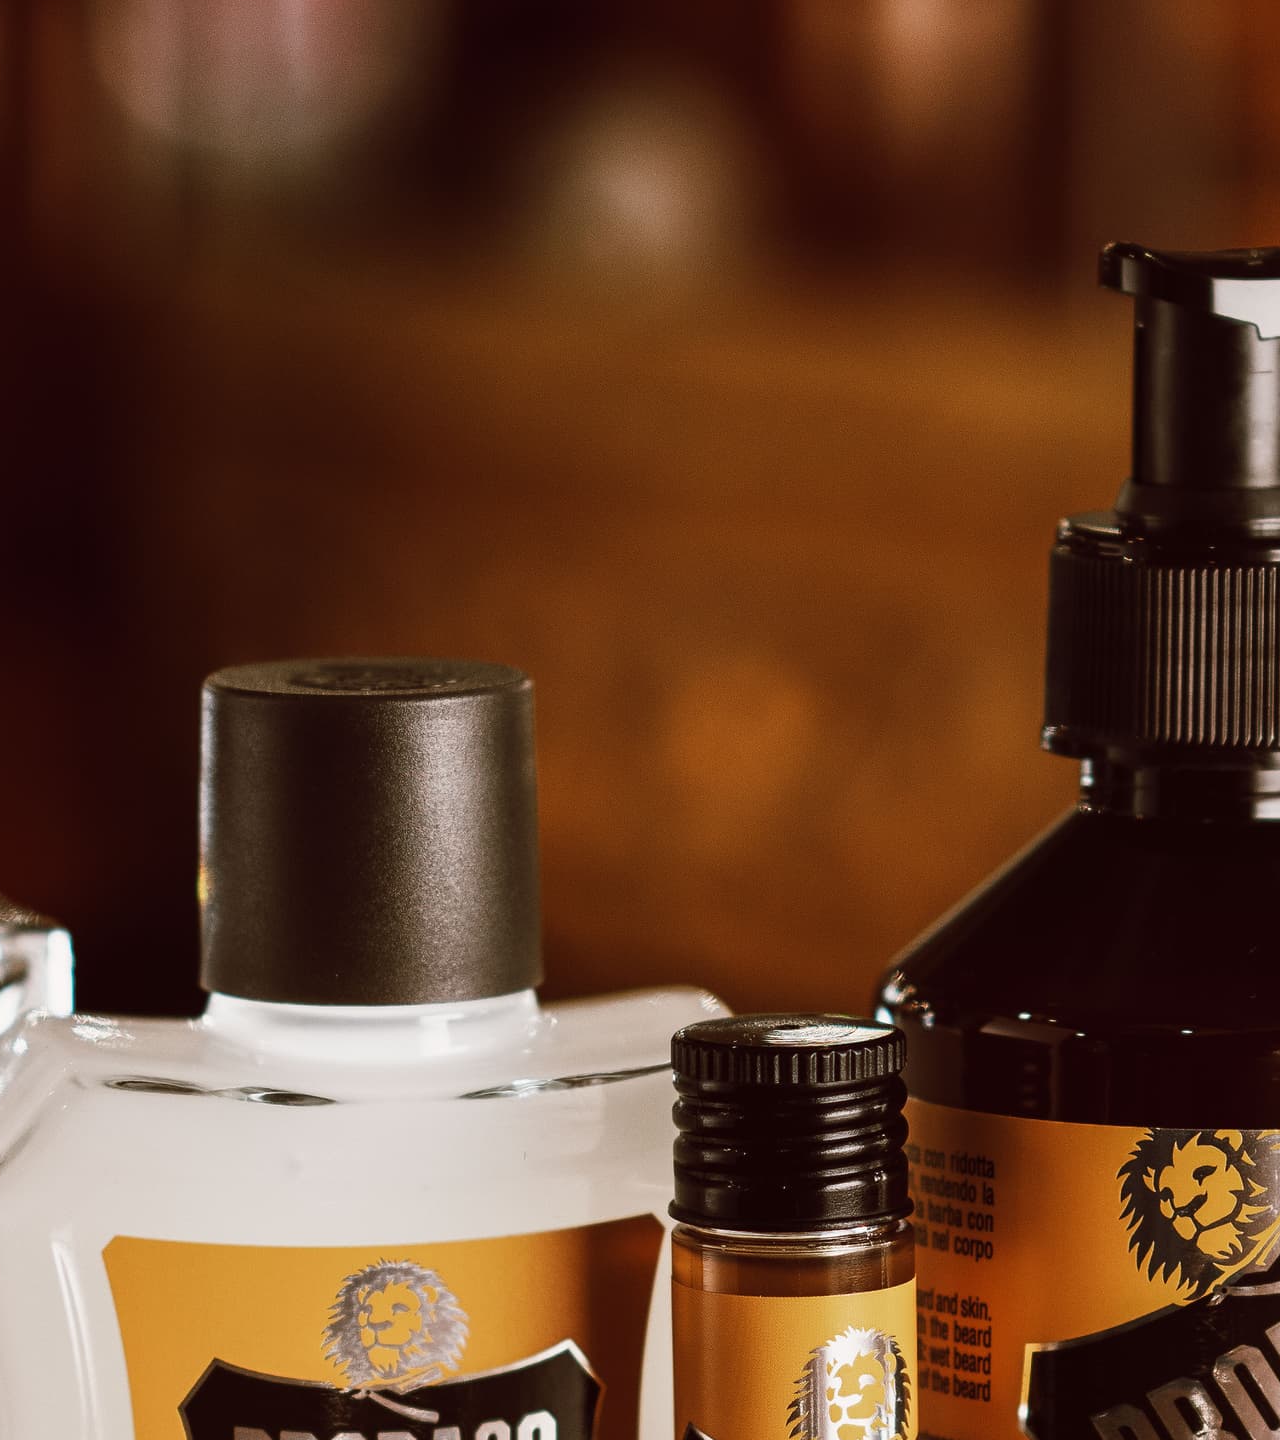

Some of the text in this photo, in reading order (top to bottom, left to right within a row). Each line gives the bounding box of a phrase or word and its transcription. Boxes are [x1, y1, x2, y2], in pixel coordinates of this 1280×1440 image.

[950, 1152, 995, 1179] ridotta
[983, 1181, 995, 1206] la
[967, 1211, 994, 1233] con
[954, 1235, 994, 1262] corpo
[936, 1293, 958, 1315] and
[960, 1296, 992, 1322] skin.
[953, 1320, 992, 1348] beard
[953, 1347, 991, 1375] beard
[953, 1373, 991, 1402] beard
